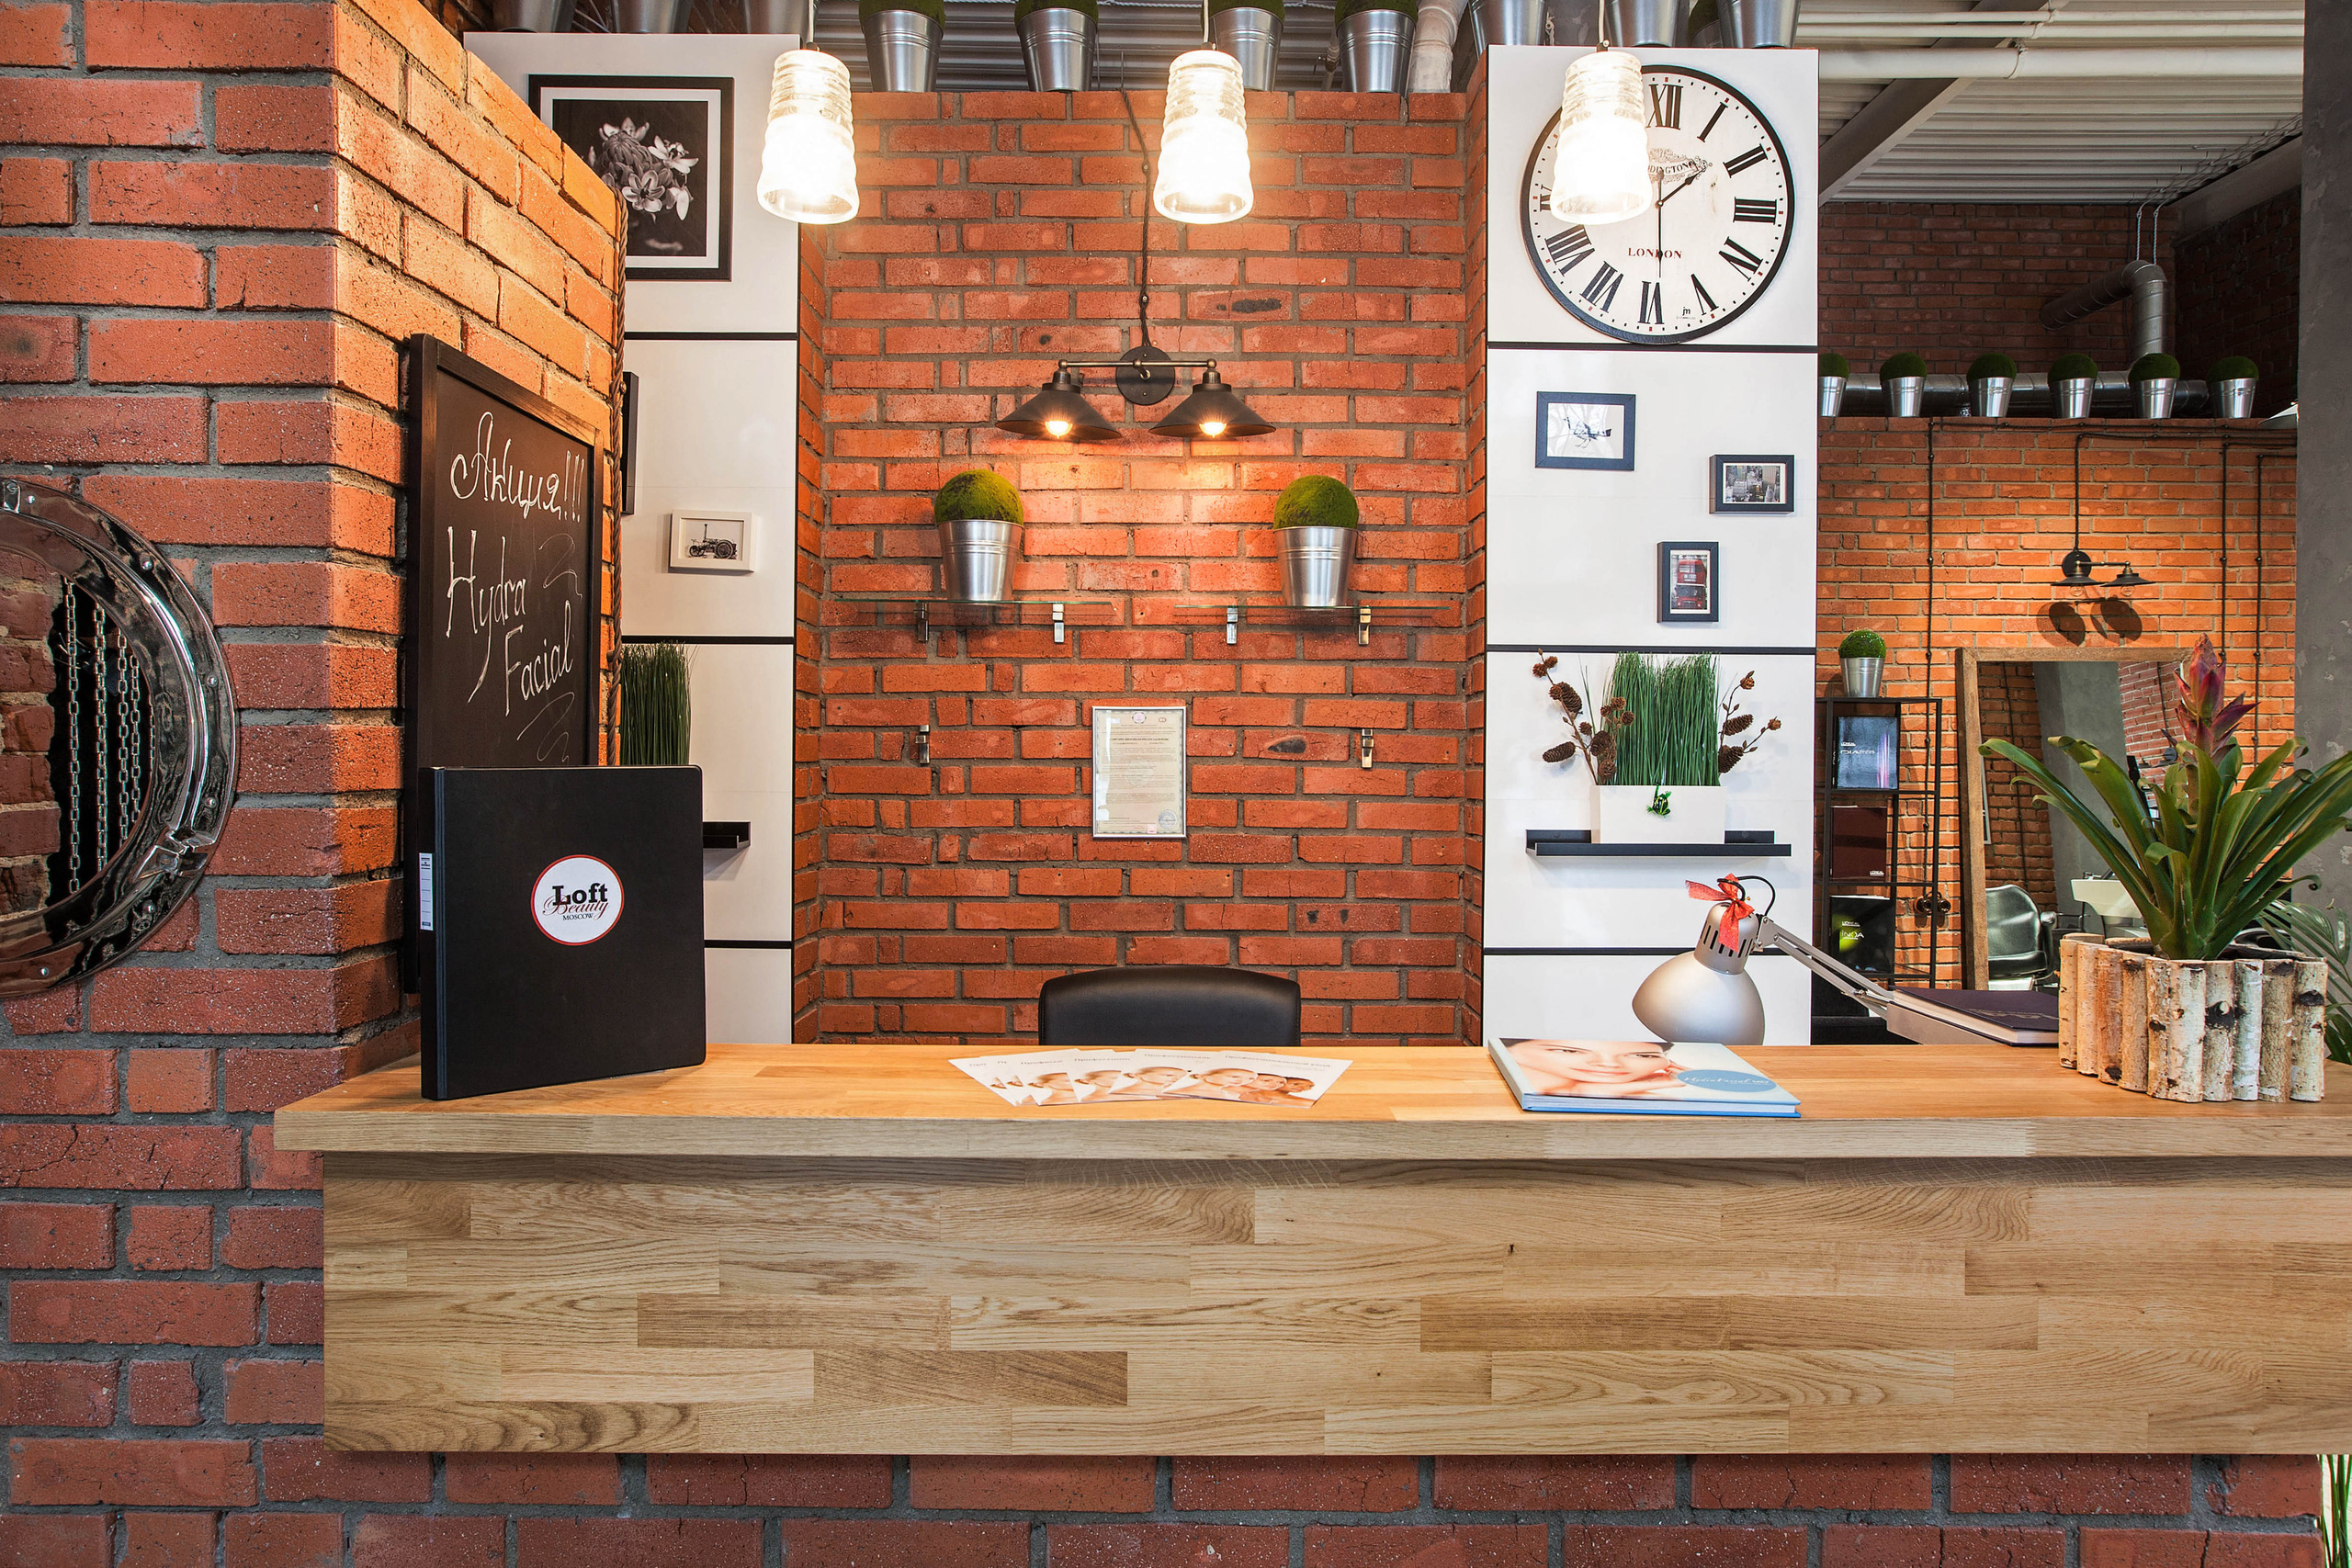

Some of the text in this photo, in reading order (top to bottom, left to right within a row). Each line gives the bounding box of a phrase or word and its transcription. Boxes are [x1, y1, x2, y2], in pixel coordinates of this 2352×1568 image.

[1645, 84, 1683, 130] XII
[1723, 143, 1768, 178] II
[1733, 197, 1777, 225] III
[1544, 223, 1596, 276] VIII
[1718, 236, 1764, 282] IV
[1579, 260, 1624, 313] VII
[1638, 280, 1665, 324] VI
[1690, 274, 1720, 316] V
[450, 411, 585, 523] Акция!!!
[446, 525, 527, 704] Hydra
[504, 600, 574, 717] Facial
[542, 895, 609, 921] Beauty
[552, 882, 608, 906] Loft
[562, 913, 594, 921] MOSCOW
